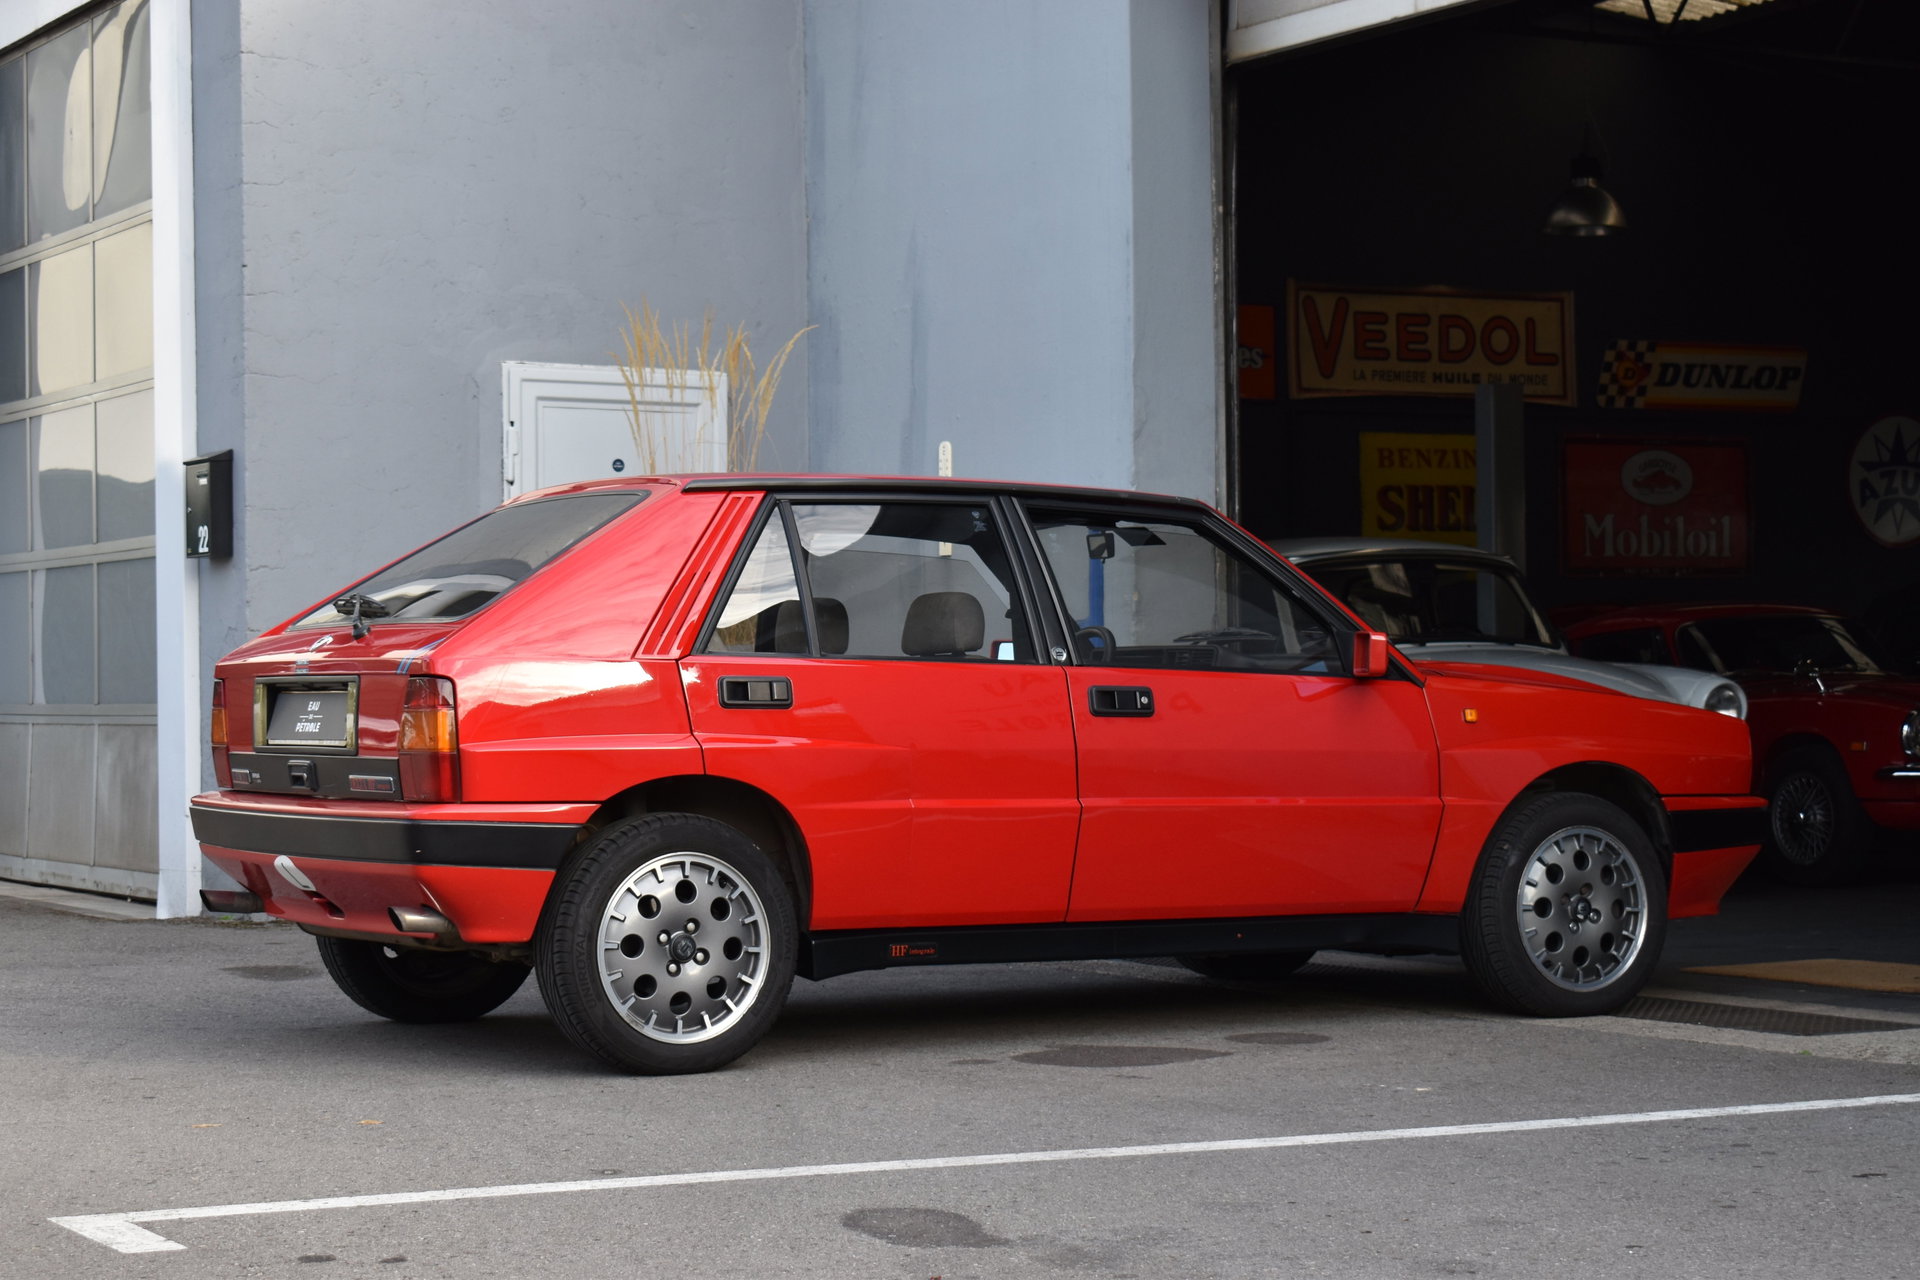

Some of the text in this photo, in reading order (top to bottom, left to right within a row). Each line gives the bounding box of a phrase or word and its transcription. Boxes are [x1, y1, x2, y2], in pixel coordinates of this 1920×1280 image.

[1302, 295, 1559, 379] VEEDOL
[1353, 369, 1367, 381] LA
[1432, 373, 1481, 384] HUILE
[1509, 374, 1548, 386] MONDE
[1654, 361, 1802, 390] DUNLOP
[198, 525, 209, 553] 22
[1584, 512, 1732, 558] Mobiloil
[307, 701, 321, 711] EAU
[891, 944, 909, 957] HF
